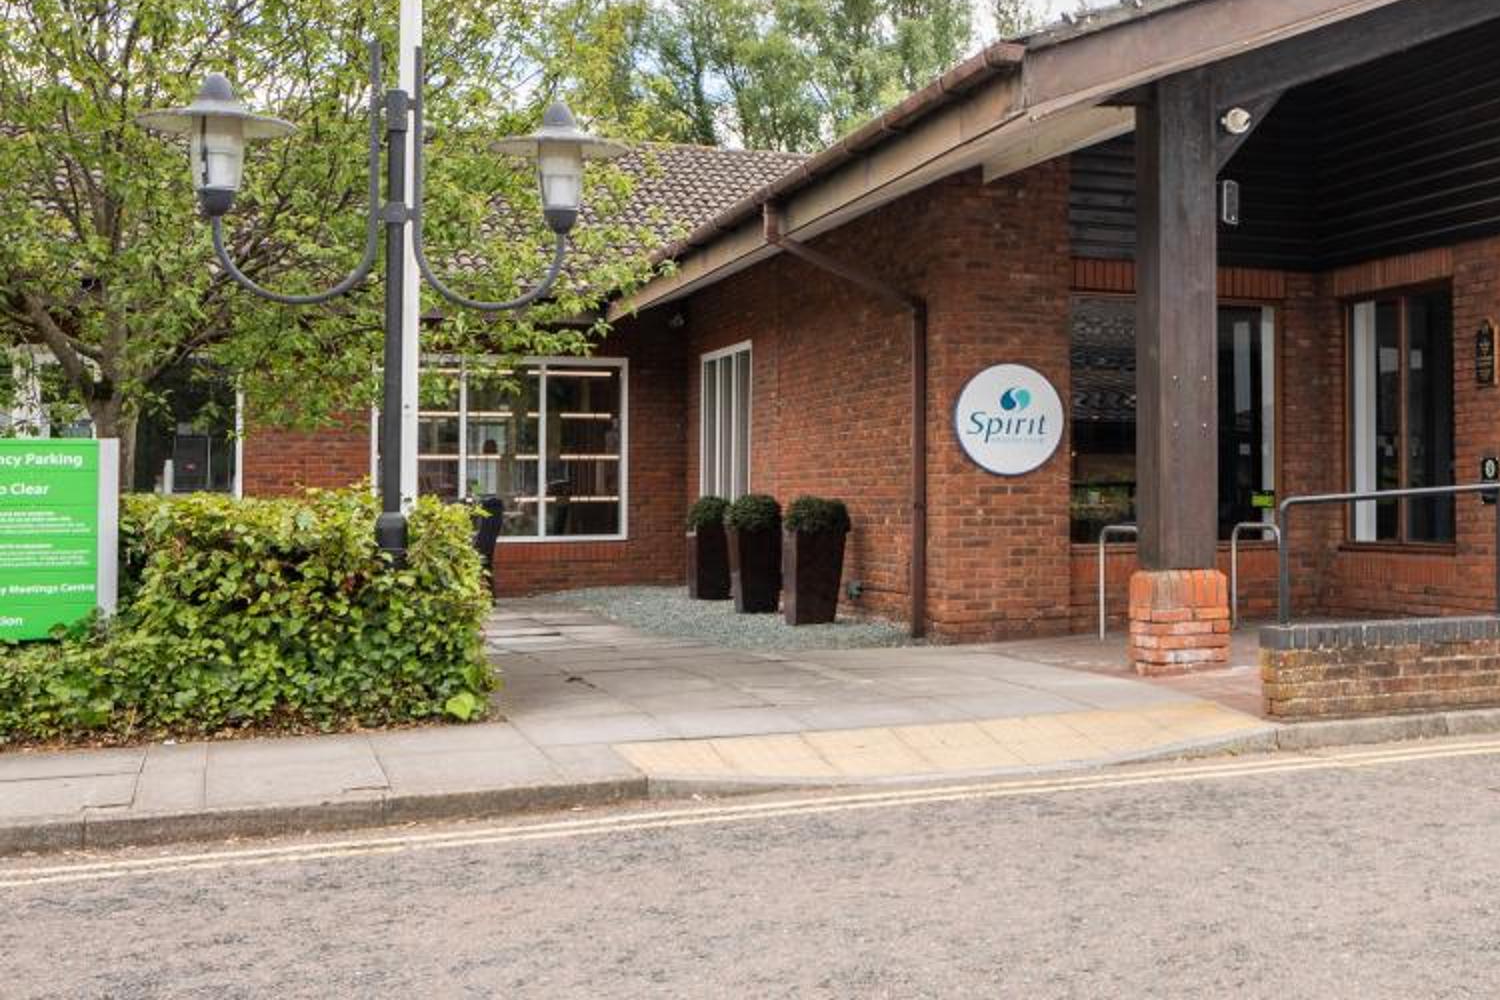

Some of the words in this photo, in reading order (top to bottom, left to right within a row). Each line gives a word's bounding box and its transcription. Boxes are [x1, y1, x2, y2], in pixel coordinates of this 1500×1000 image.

[966, 411, 1048, 444] Spirit
[25, 452, 84, 469] Parking
[10, 482, 49, 496] Clear
[9, 584, 58, 595] Meetings
[60, 583, 95, 593] Centre
